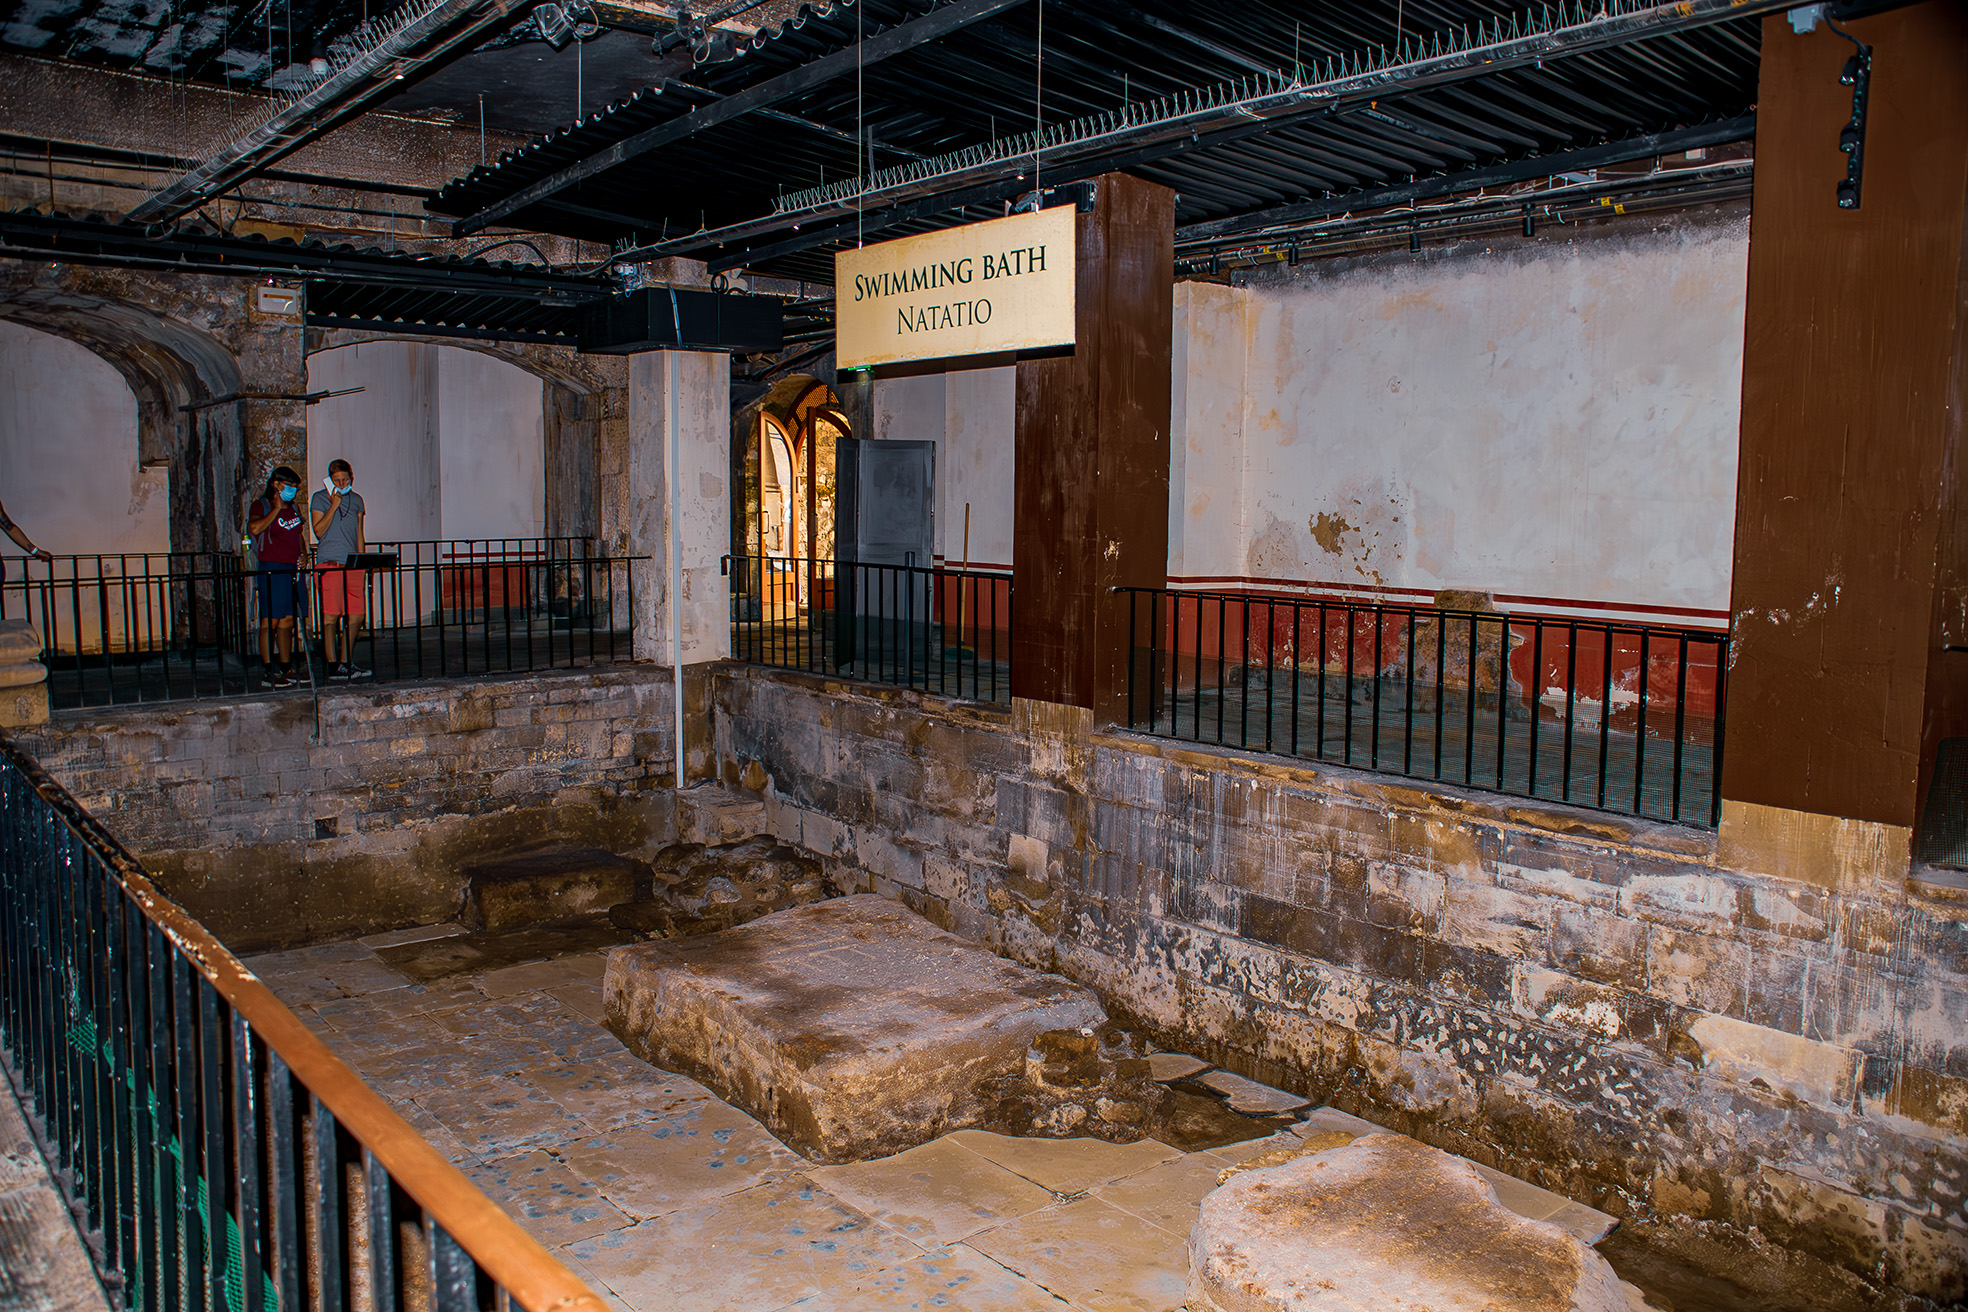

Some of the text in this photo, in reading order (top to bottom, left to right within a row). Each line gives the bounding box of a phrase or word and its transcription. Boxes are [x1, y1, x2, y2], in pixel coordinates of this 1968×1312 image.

[854, 245, 1047, 301] SWIMMING BATH
[897, 298, 992, 335] NATATIO
